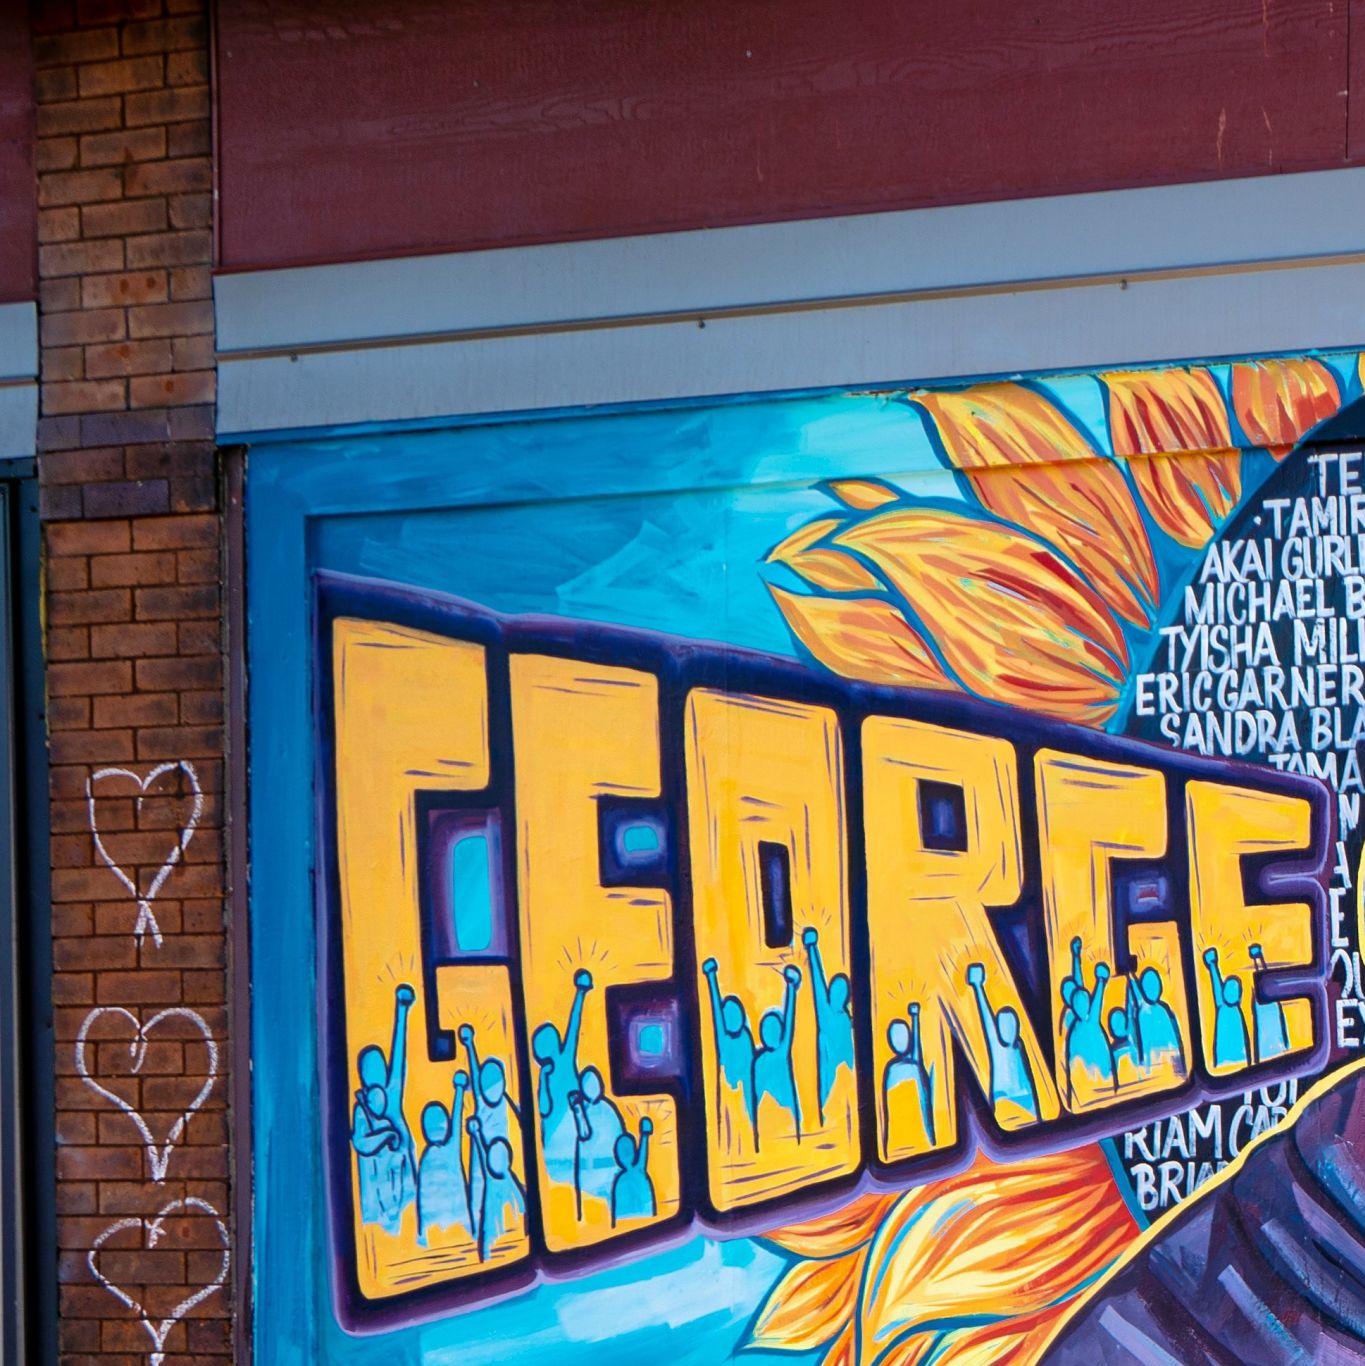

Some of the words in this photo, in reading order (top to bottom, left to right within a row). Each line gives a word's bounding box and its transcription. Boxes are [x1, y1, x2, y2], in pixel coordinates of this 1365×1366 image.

[1200, 539, 1273, 583] AKAI
[1185, 580, 1334, 626] MICHAEL
[1158, 625, 1279, 673] TYISHA
[1136, 672, 1210, 716] ERIC
[1160, 711, 1289, 755] SANDRA
[328, 610, 1317, 1302] GEORGE
